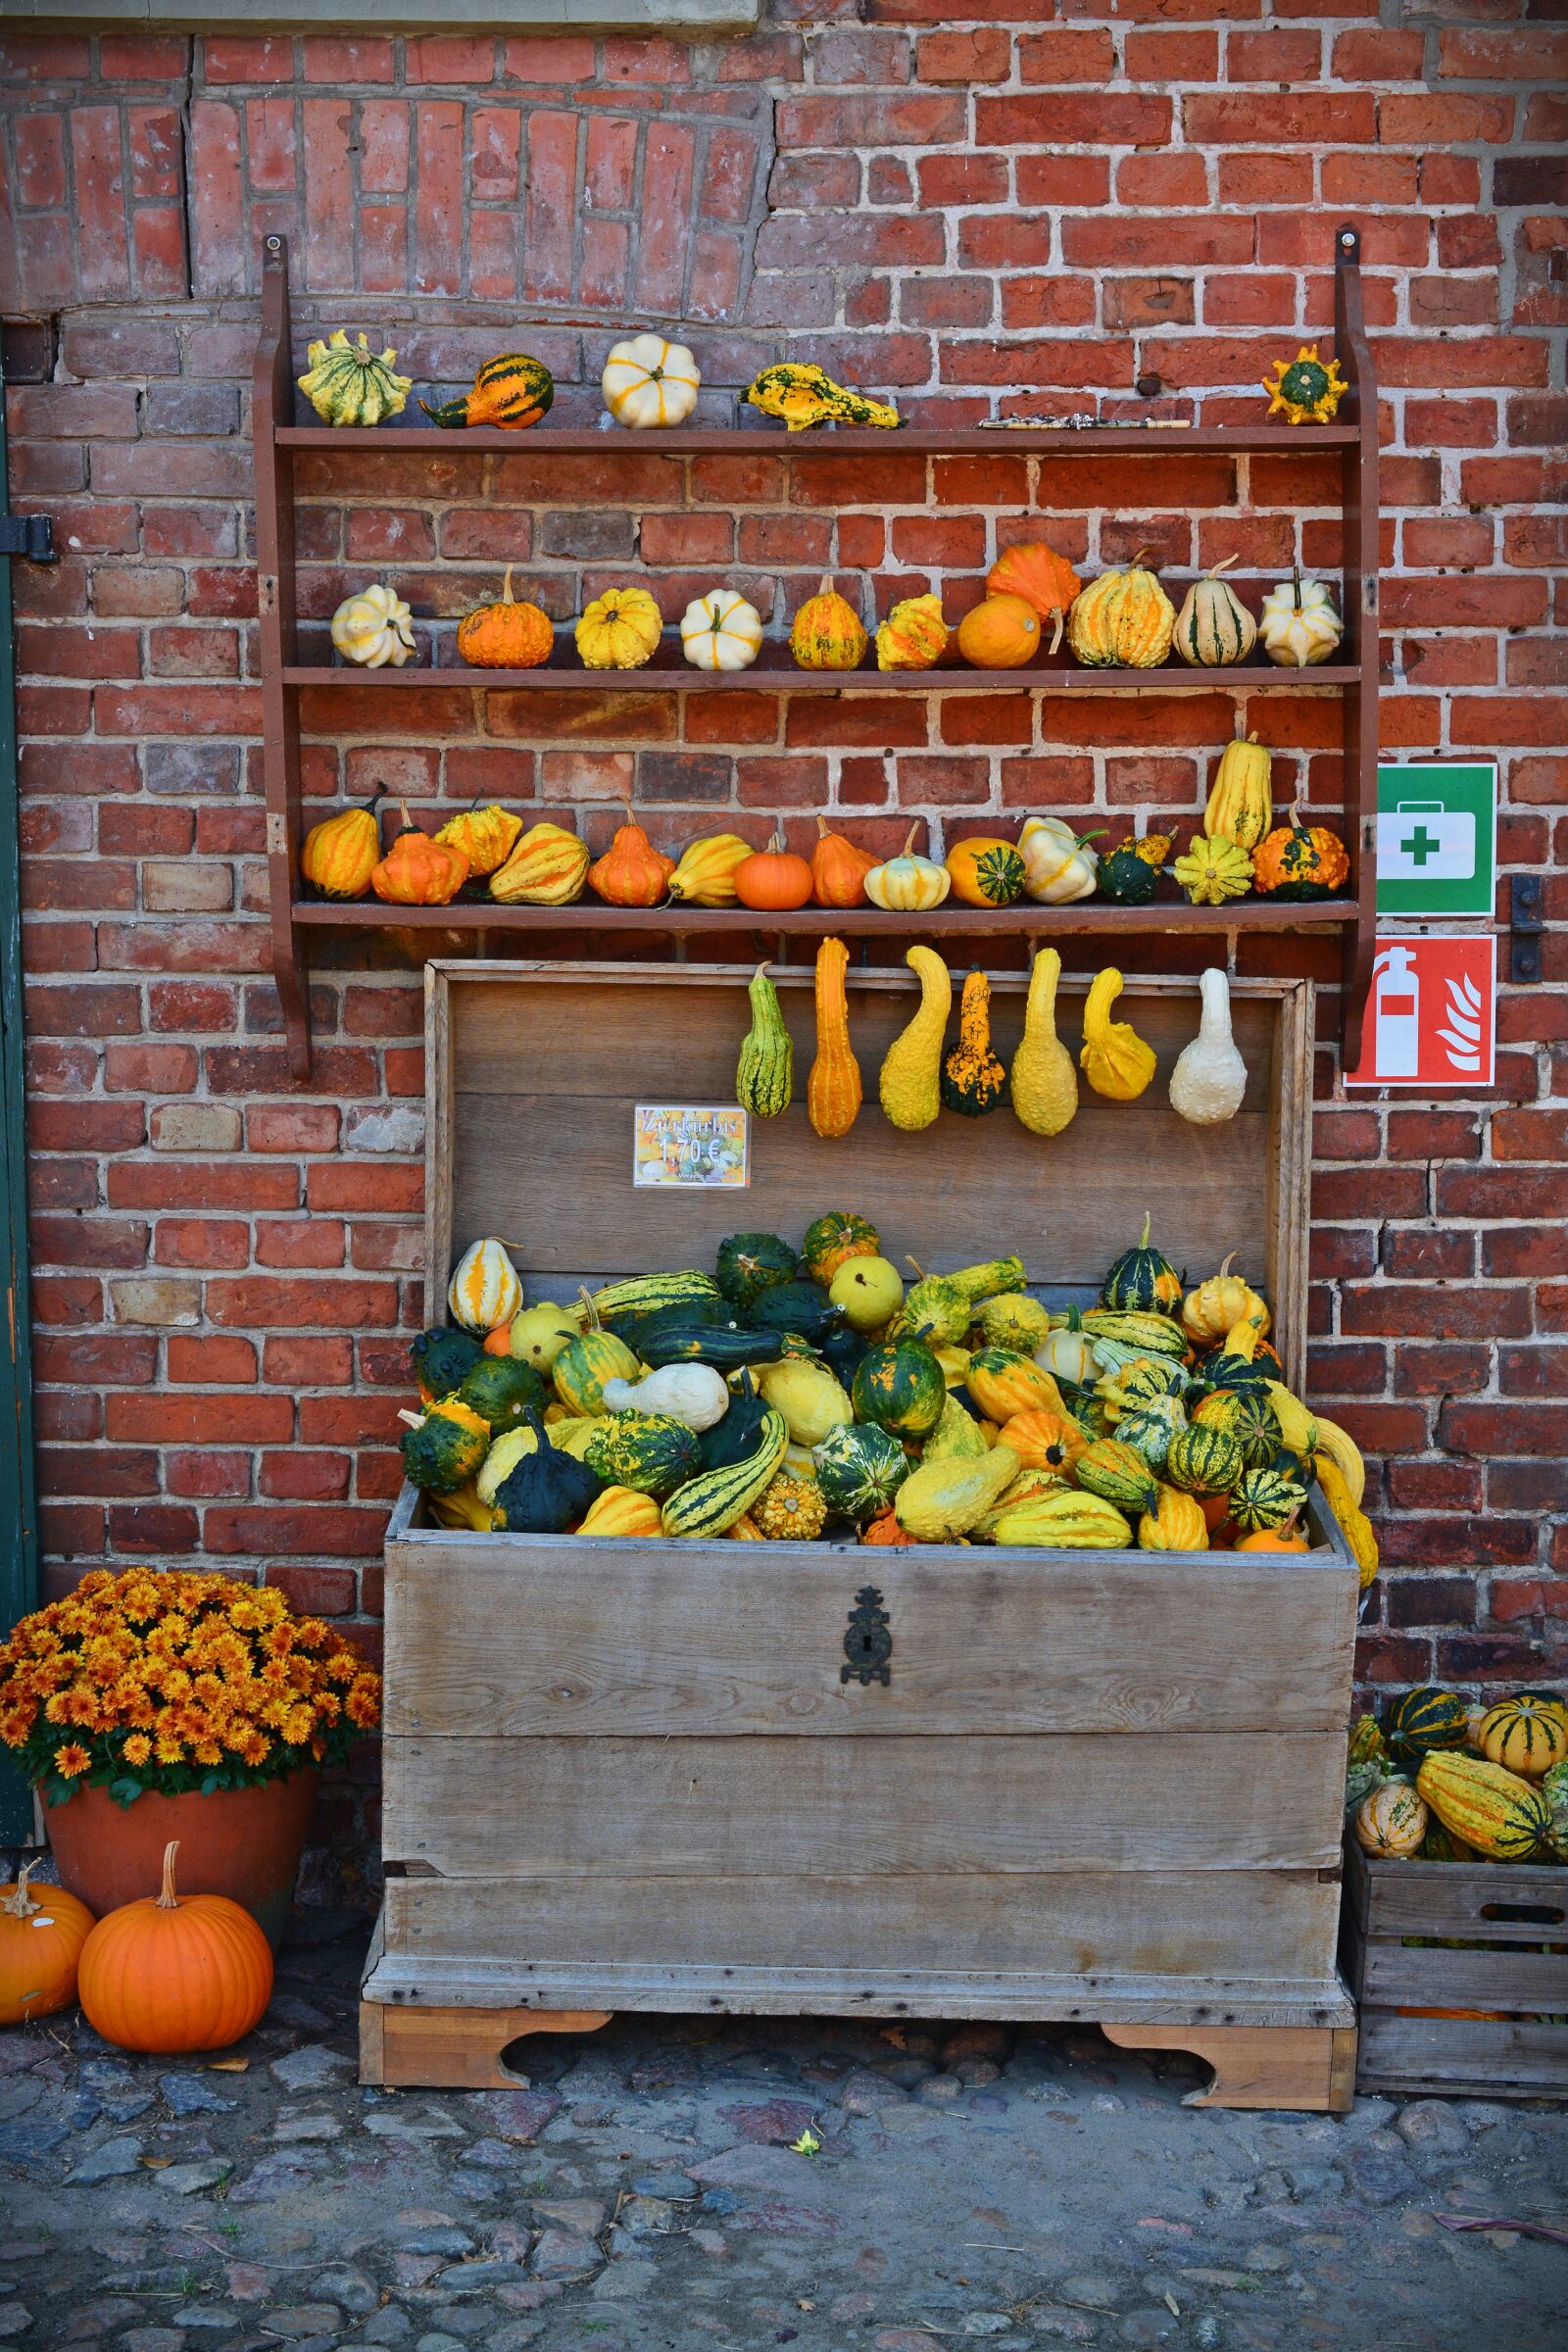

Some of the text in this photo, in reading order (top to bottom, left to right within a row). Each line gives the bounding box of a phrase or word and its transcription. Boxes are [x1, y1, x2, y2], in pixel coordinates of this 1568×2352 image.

[643, 1109, 737, 1133] Zierkürbis
[660, 1138, 721, 1167] 1,70 €
